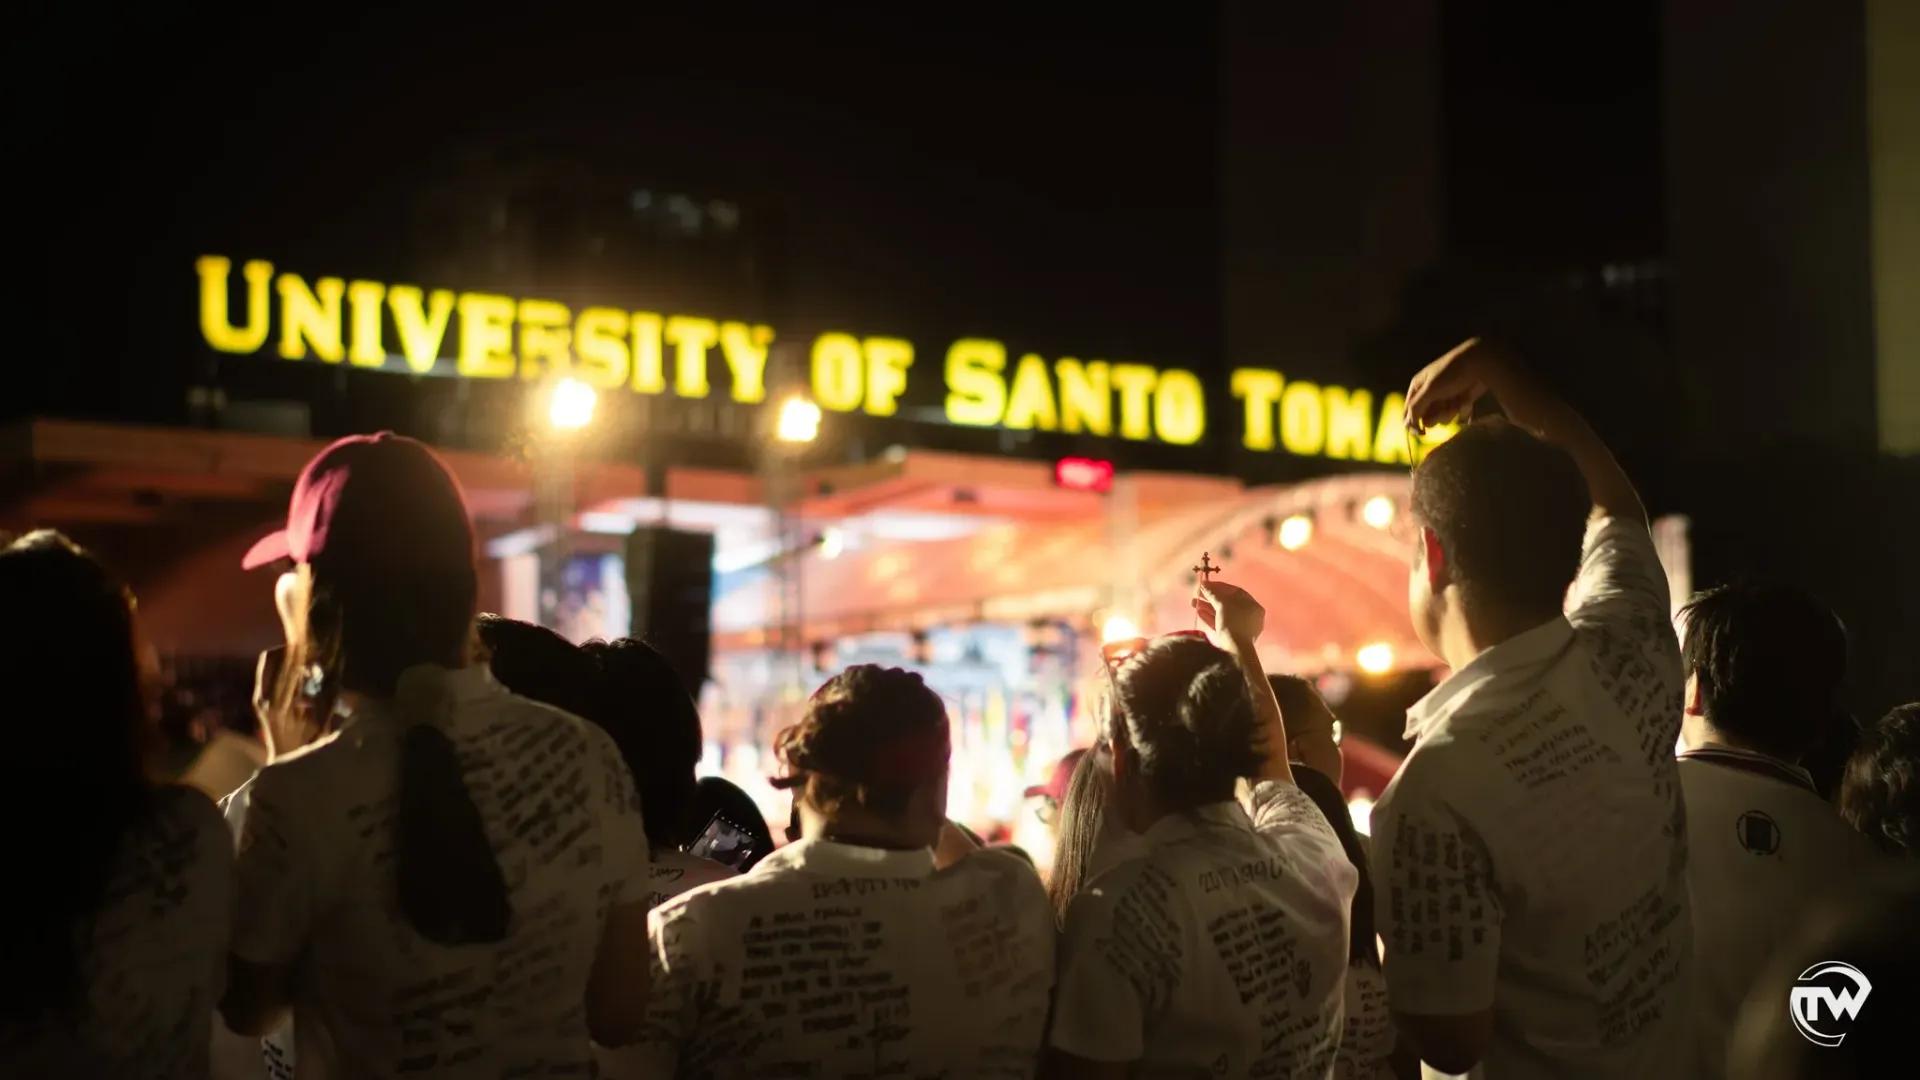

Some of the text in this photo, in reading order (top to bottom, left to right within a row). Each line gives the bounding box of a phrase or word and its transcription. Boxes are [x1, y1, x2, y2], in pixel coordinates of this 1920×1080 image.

[196, 255, 775, 404] UNIVERSITY
[811, 332, 914, 416] OF
[944, 338, 1205, 445] SANTO
